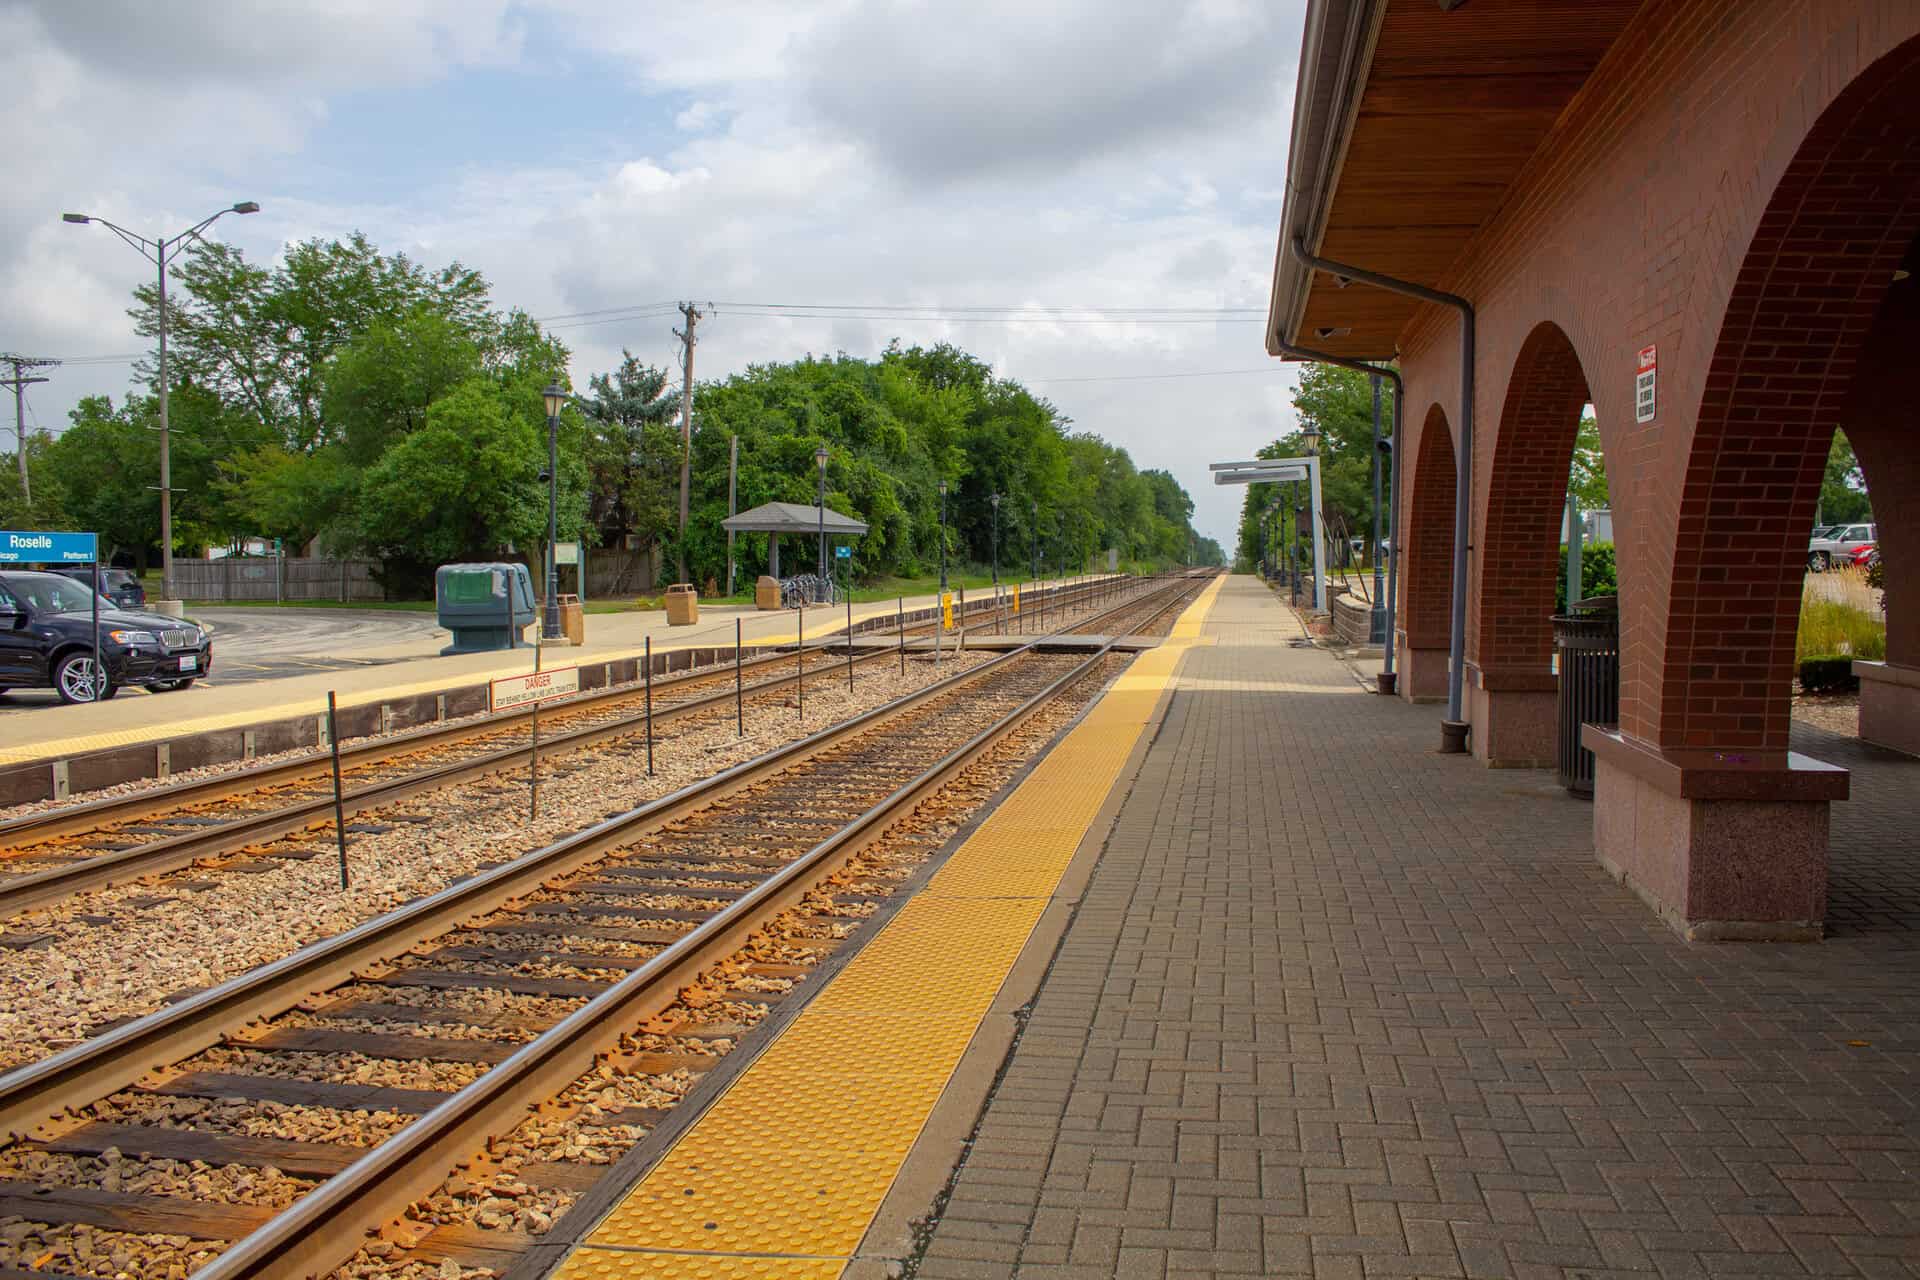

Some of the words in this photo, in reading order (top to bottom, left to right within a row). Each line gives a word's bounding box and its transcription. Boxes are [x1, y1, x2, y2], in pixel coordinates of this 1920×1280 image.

[10, 535, 52, 548] Roselle
[63, 551, 88, 559] Platform
[525, 675, 551, 689] DANGER
